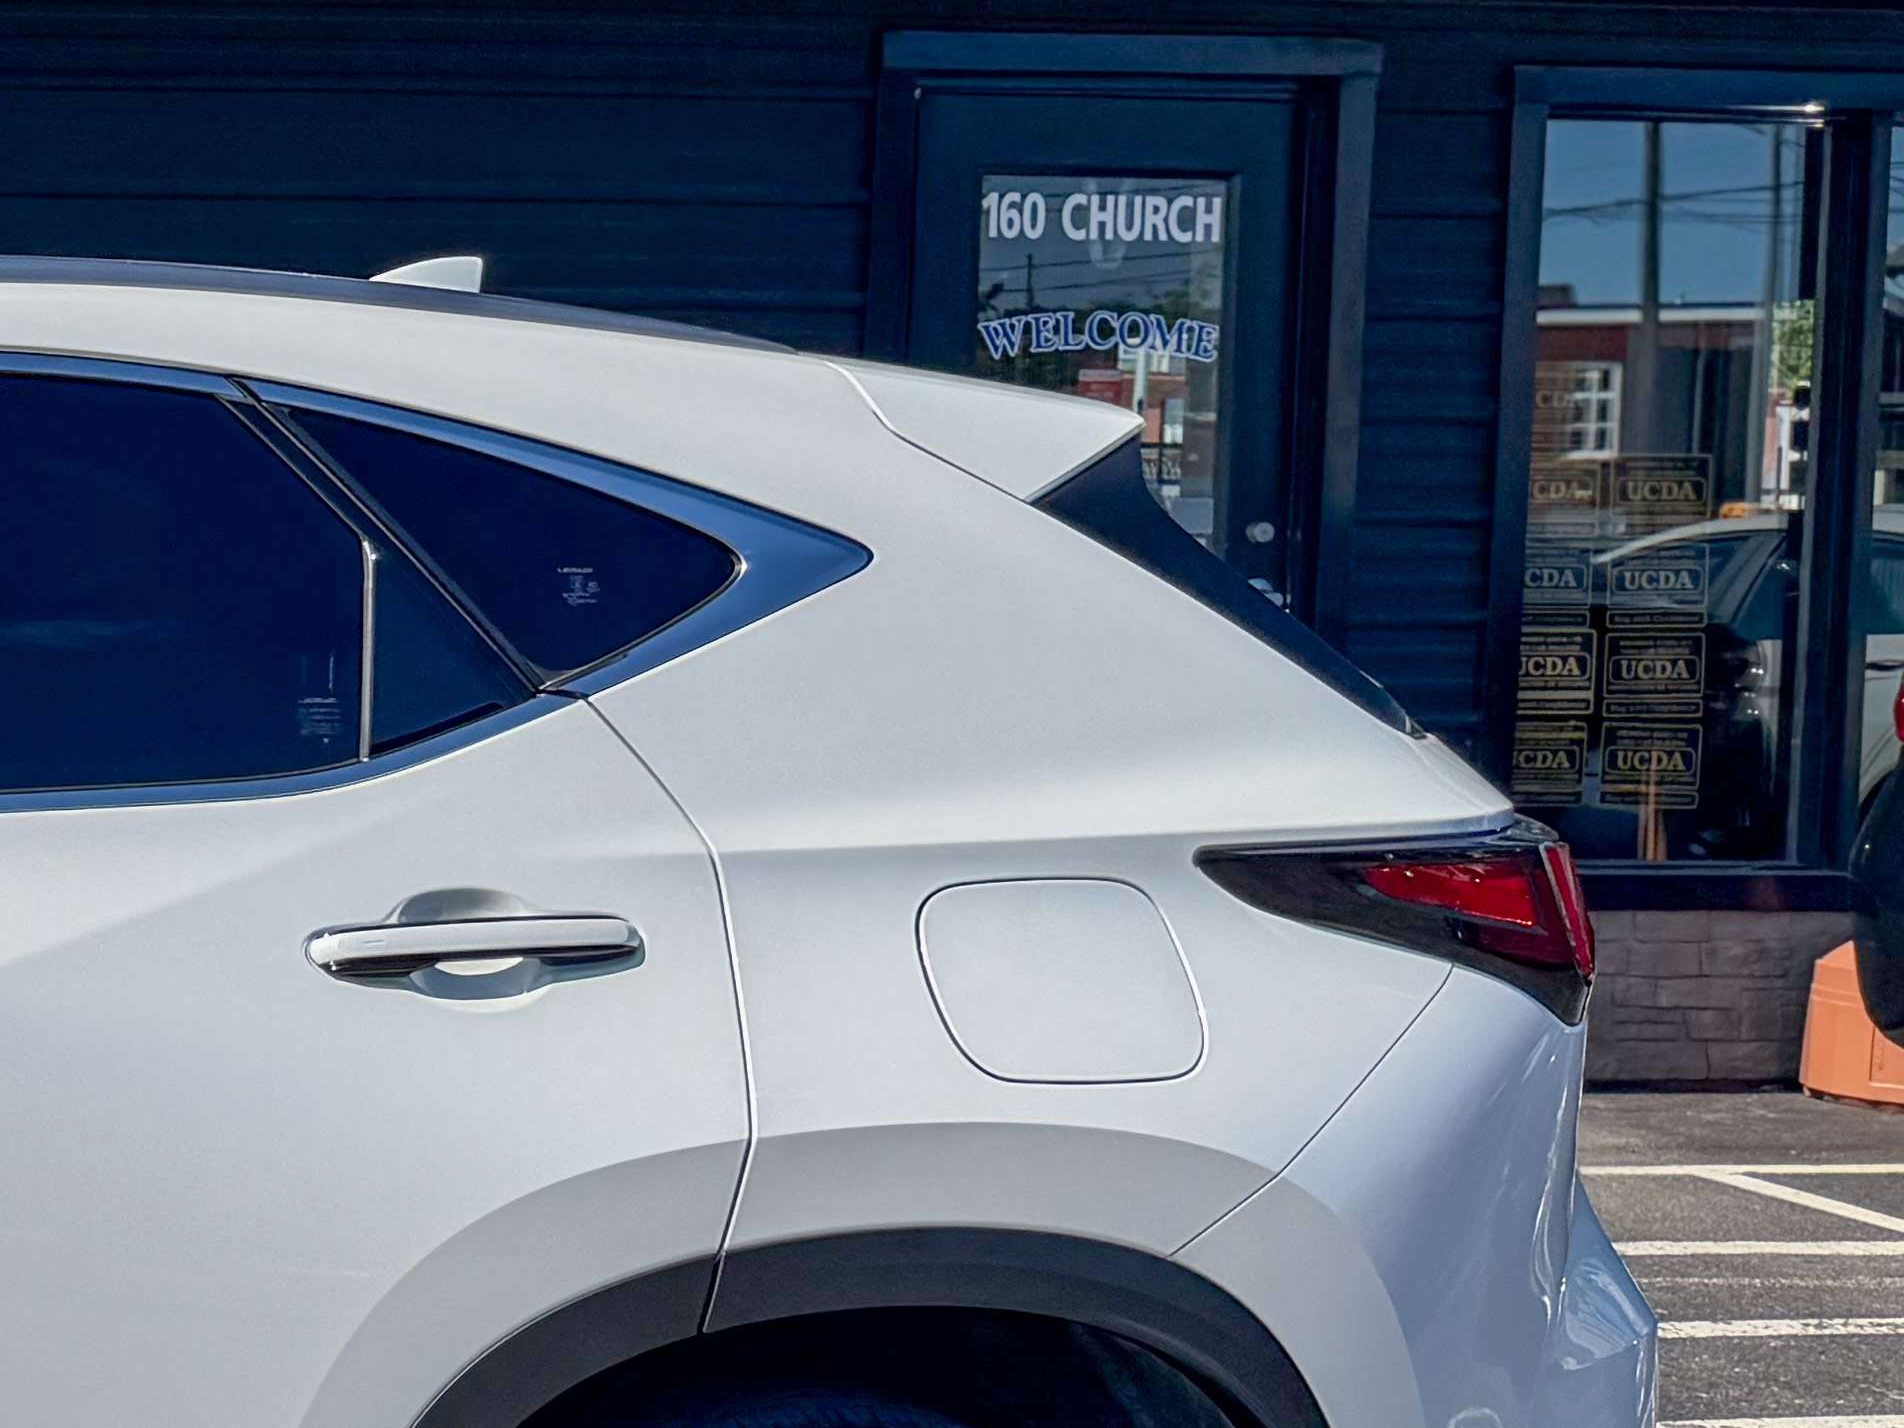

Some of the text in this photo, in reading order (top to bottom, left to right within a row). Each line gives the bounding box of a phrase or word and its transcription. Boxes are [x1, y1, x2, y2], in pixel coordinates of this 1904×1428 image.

[981, 192, 1222, 243] 160 CHURCH
[977, 311, 1220, 363] WELCOME
[1532, 480, 1582, 500] CDA
[1626, 480, 1696, 500] UCDA
[1524, 568, 1578, 588] CDA
[1622, 569, 1693, 589] UCDA
[1620, 659, 1690, 679] UCDA
[1513, 750, 1570, 769] CDA
[1616, 750, 1686, 771] UCDA
